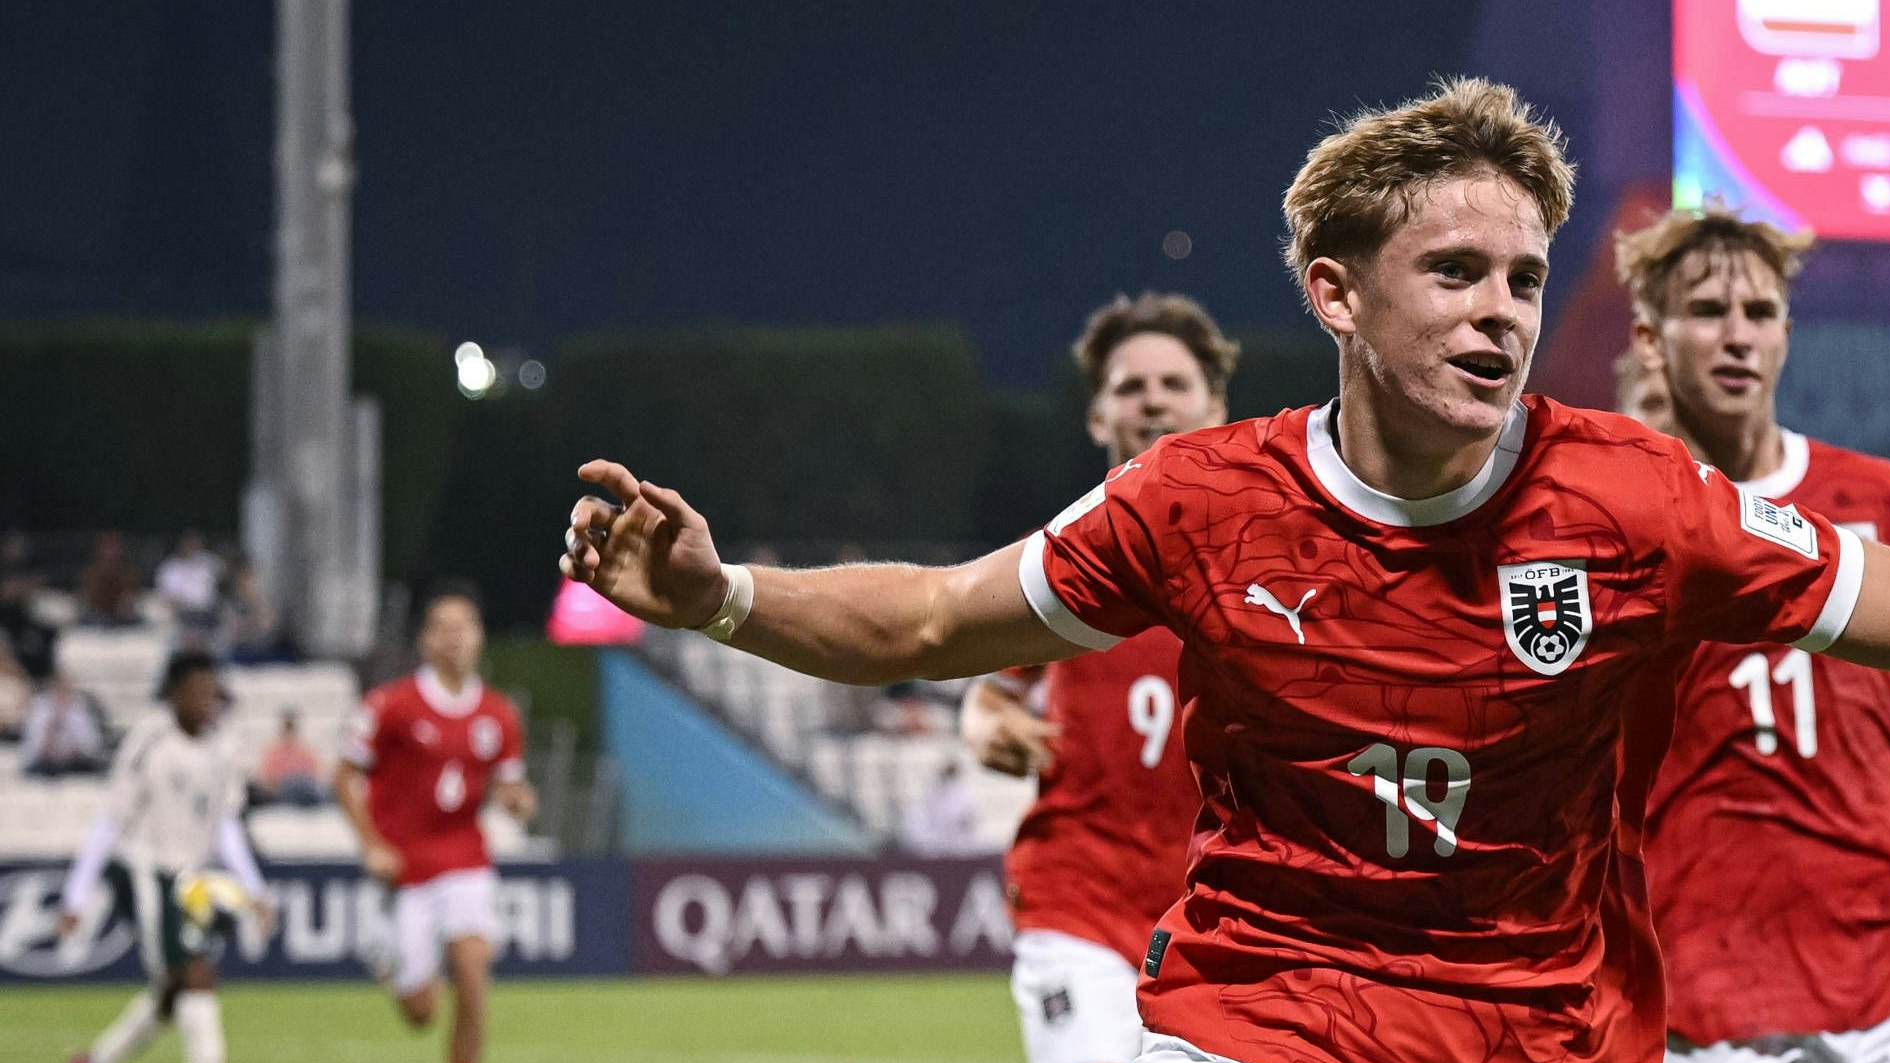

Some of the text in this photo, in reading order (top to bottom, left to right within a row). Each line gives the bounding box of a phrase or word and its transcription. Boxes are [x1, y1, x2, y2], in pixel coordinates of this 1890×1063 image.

[1525, 567, 1560, 580] ÖFB
[1127, 675, 1175, 769] 9
[1728, 647, 1818, 759] 11
[1347, 742, 1472, 858] 19
[653, 872, 939, 974] QATAR
